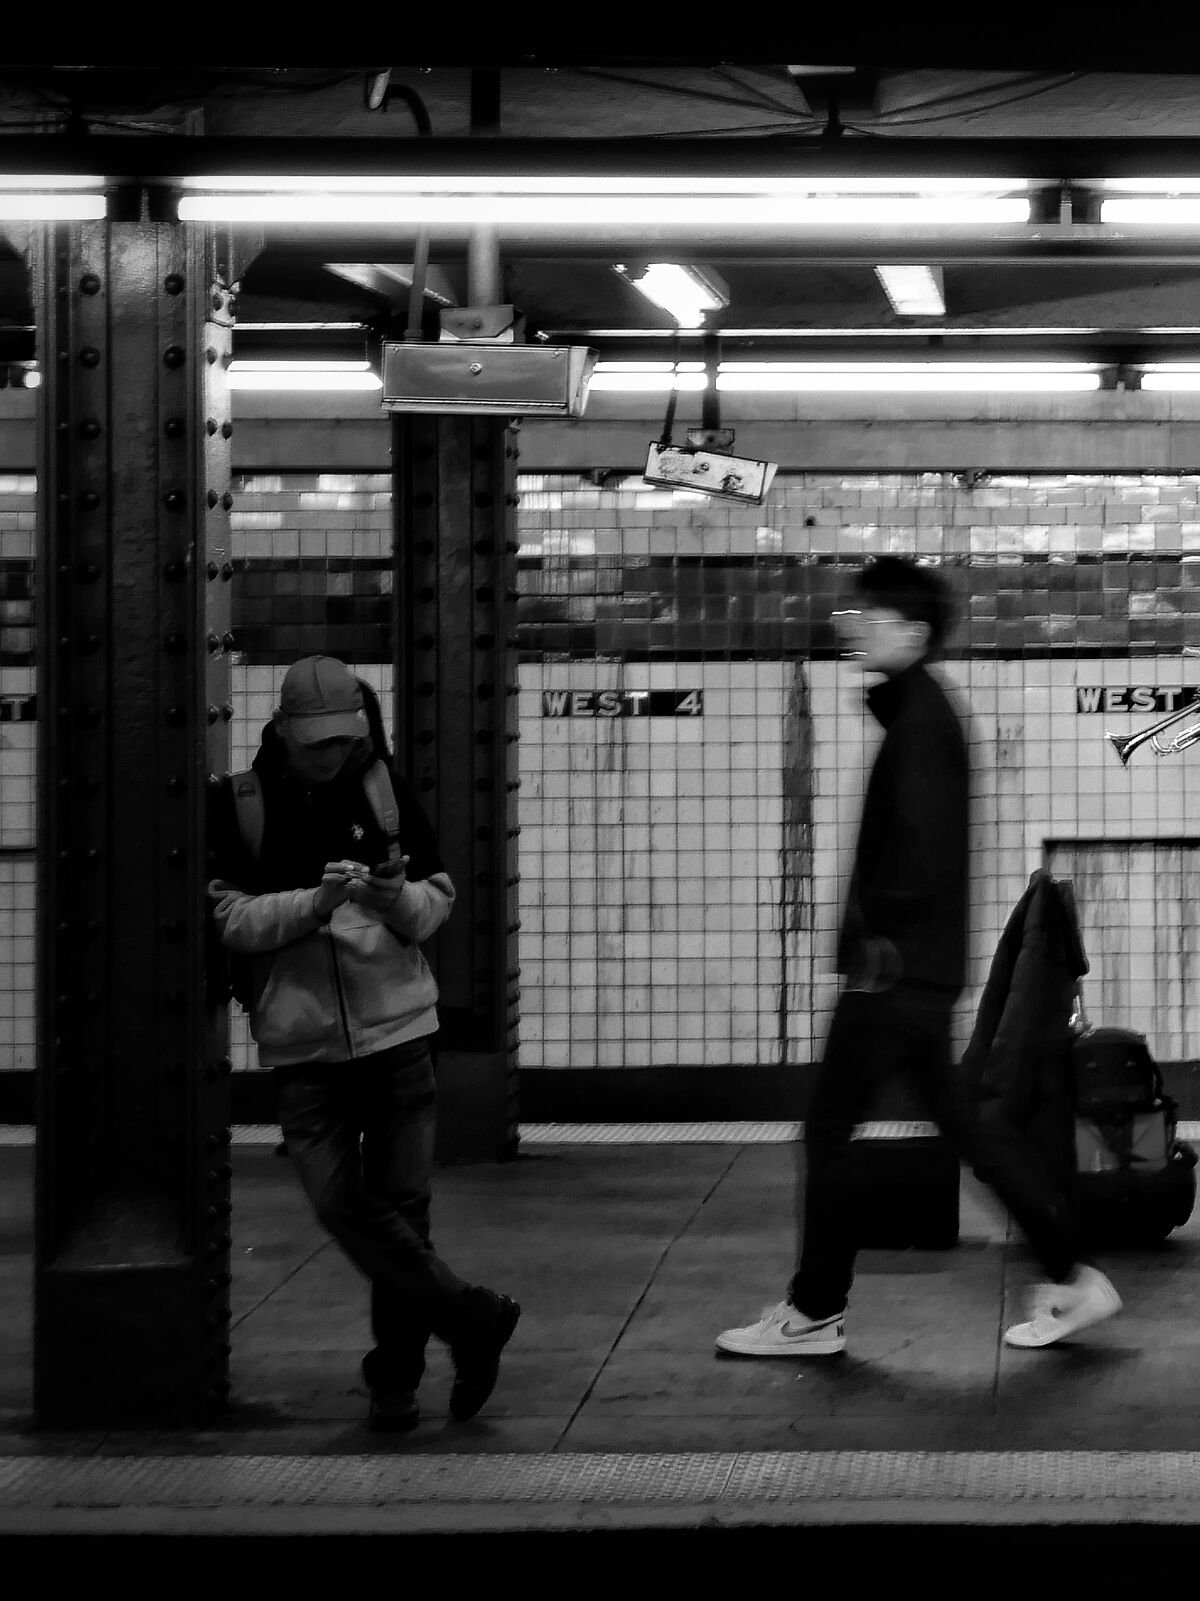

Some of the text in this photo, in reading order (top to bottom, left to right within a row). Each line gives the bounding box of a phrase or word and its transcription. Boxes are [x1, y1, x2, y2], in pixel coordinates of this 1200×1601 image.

[543, 690, 702, 717] WEST 4
[1077, 686, 1183, 713] WEST
